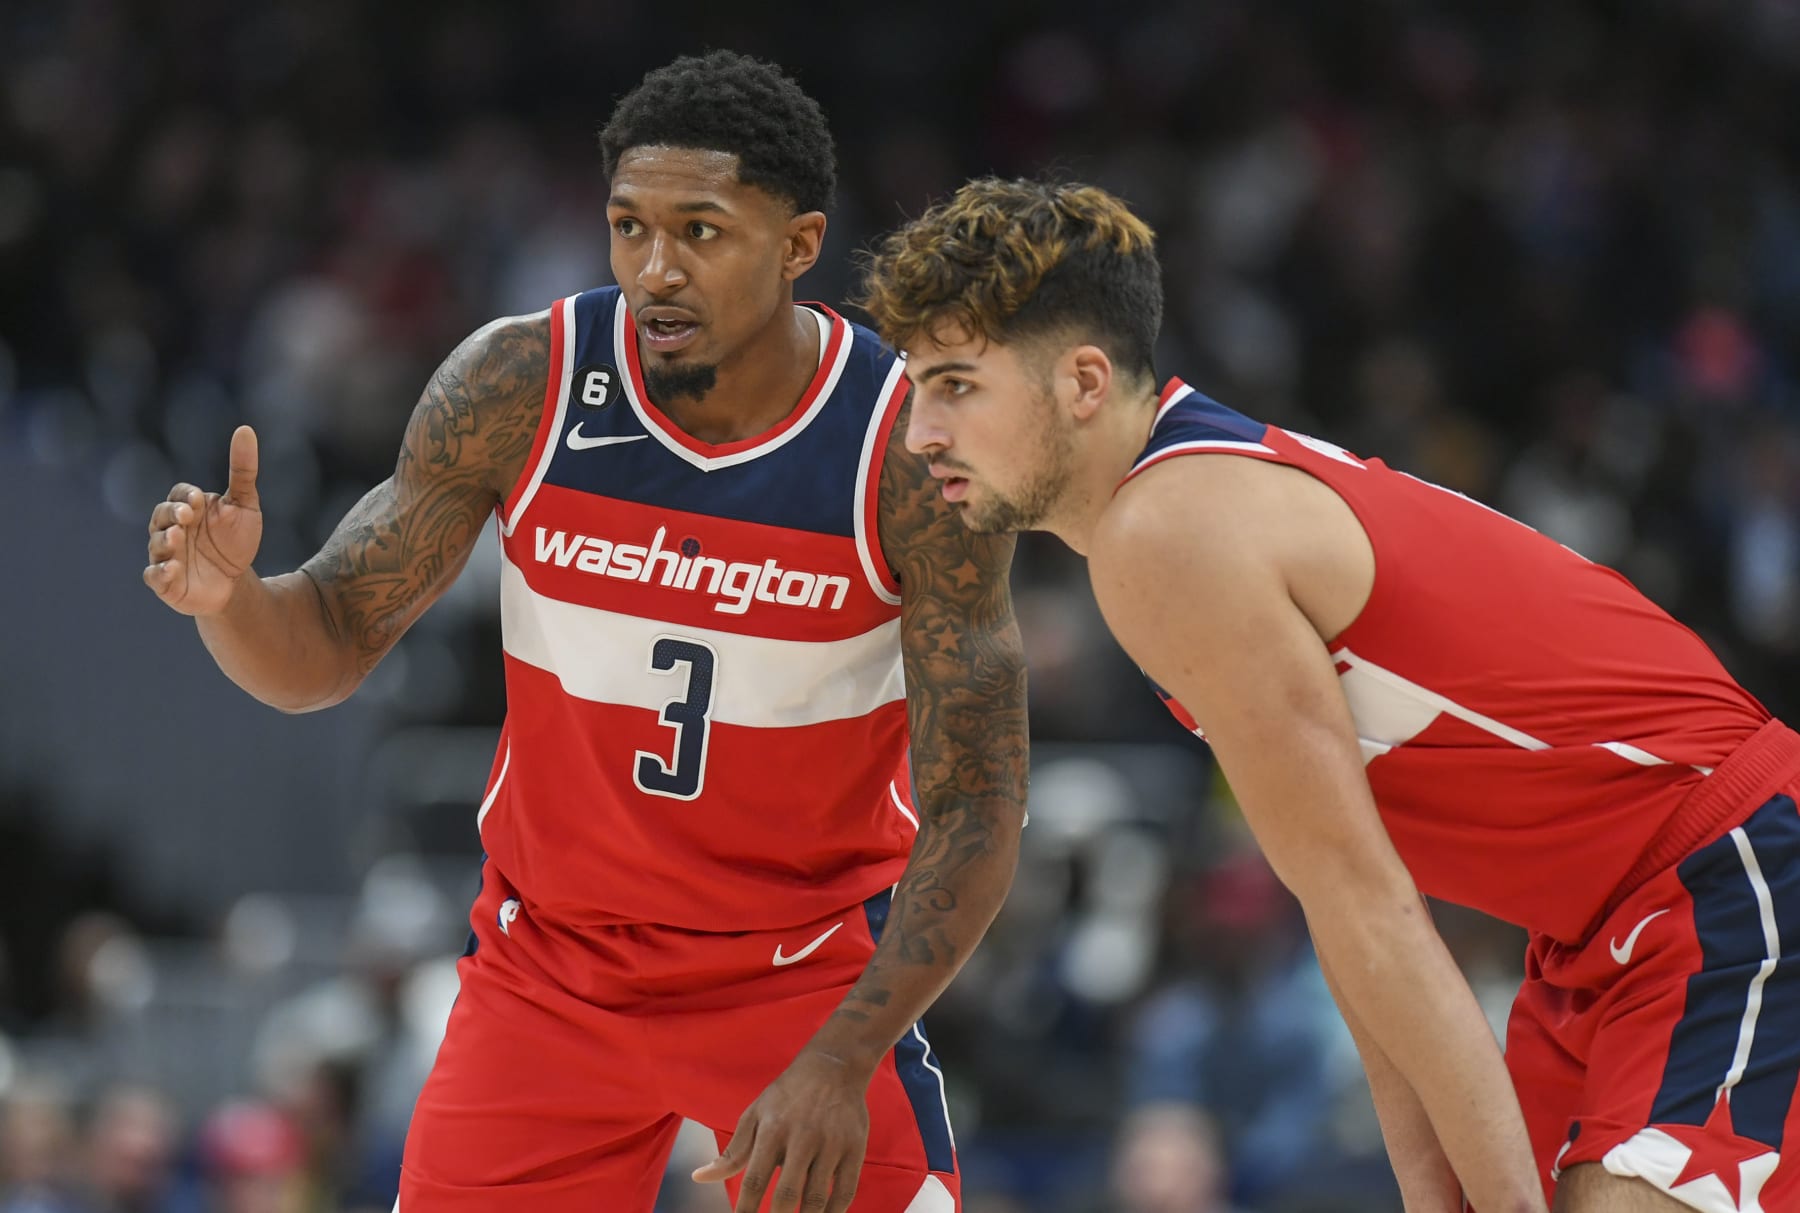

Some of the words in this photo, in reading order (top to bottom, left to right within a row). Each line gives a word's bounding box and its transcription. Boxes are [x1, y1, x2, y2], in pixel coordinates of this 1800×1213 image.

[581, 370, 610, 406] 6
[534, 526, 850, 615] washington
[633, 633, 719, 801] 3
